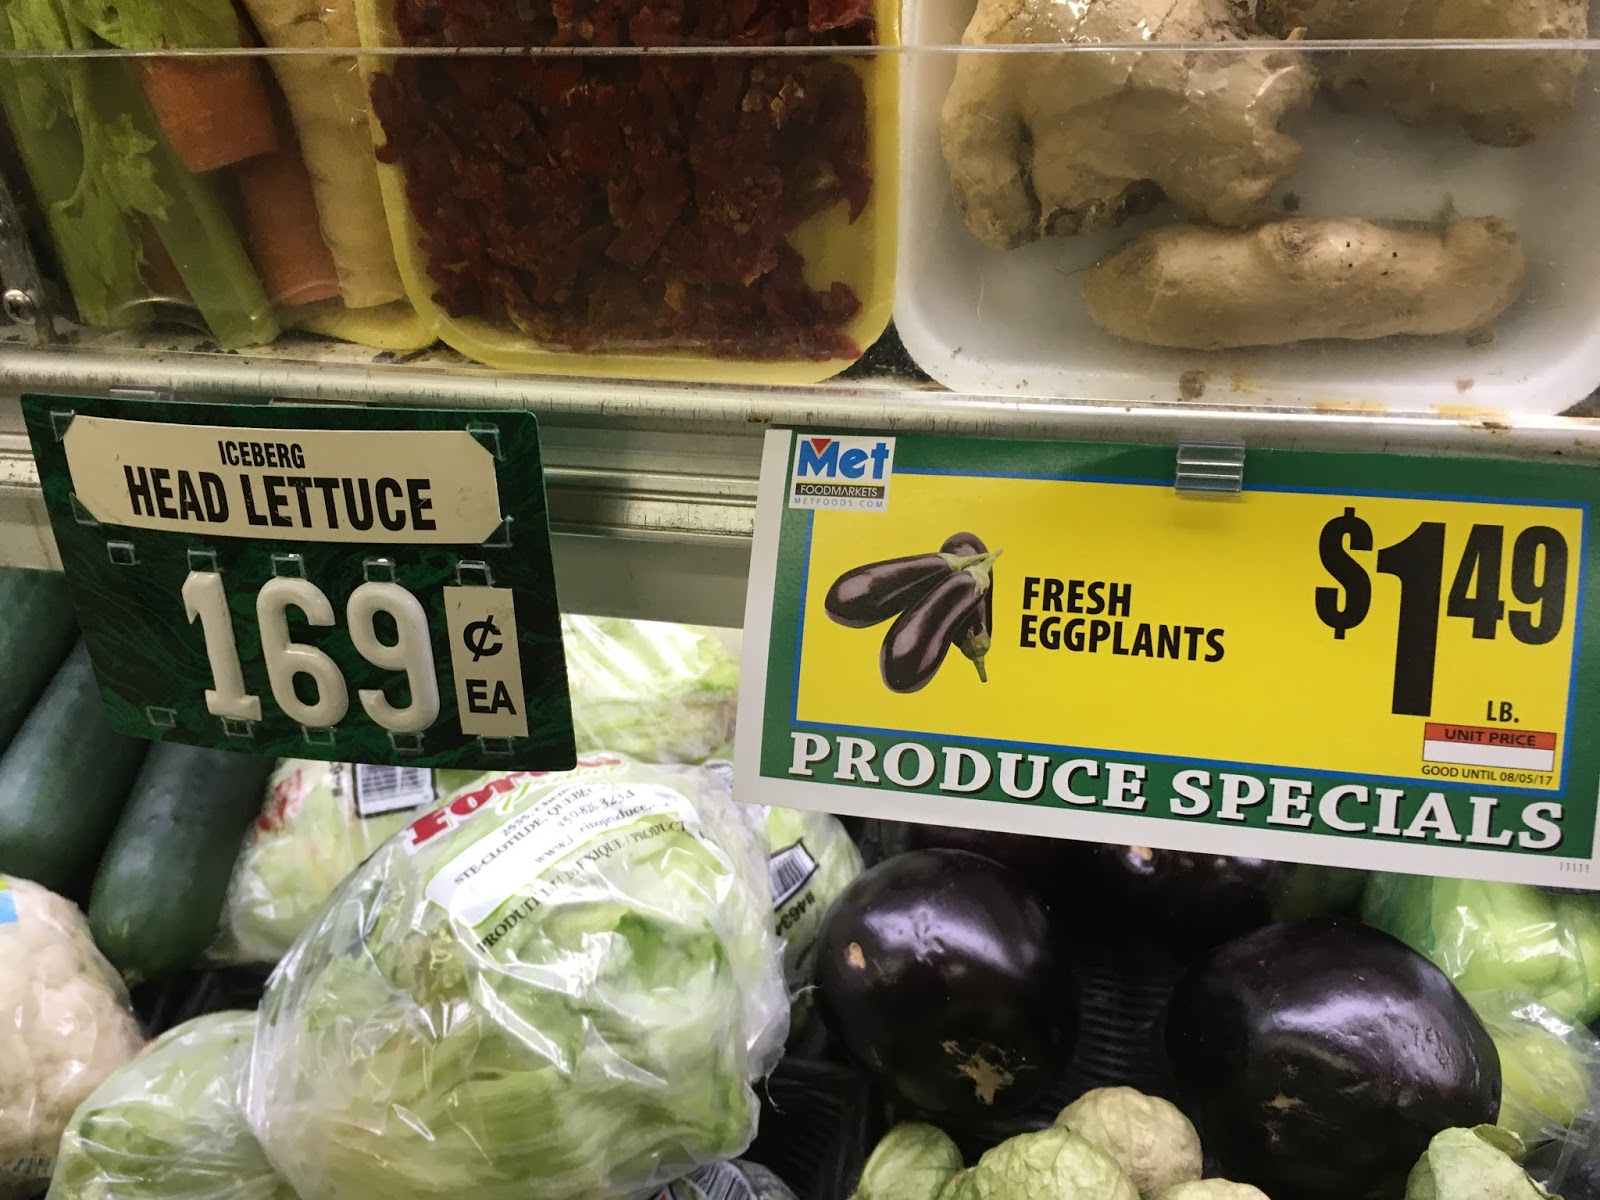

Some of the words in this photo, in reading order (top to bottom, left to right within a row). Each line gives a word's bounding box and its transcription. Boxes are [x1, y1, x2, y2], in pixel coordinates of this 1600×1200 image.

[218, 440, 306, 469] ICEBERG
[797, 439, 890, 480] Met
[124, 465, 230, 523] HEAD
[240, 473, 437, 531] LETTUCE
[800, 484, 878, 497] FOODMARKETS
[1022, 576, 1133, 617] FRESH
[1019, 614, 1226, 663] EGGPLANTS
[465, 680, 518, 716] EA
[1486, 700, 1520, 724] LB.
[1443, 728, 1486, 743] UNIT
[1488, 732, 1537, 747] PRICE
[788, 731, 1148, 811] PRODUCE
[1169, 769, 1564, 850] SPECIALS
[1421, 765, 1459, 778] GOOD
[1461, 768, 1498, 781] UNTIL
[1499, 772, 1553, 786] 08/05/17
